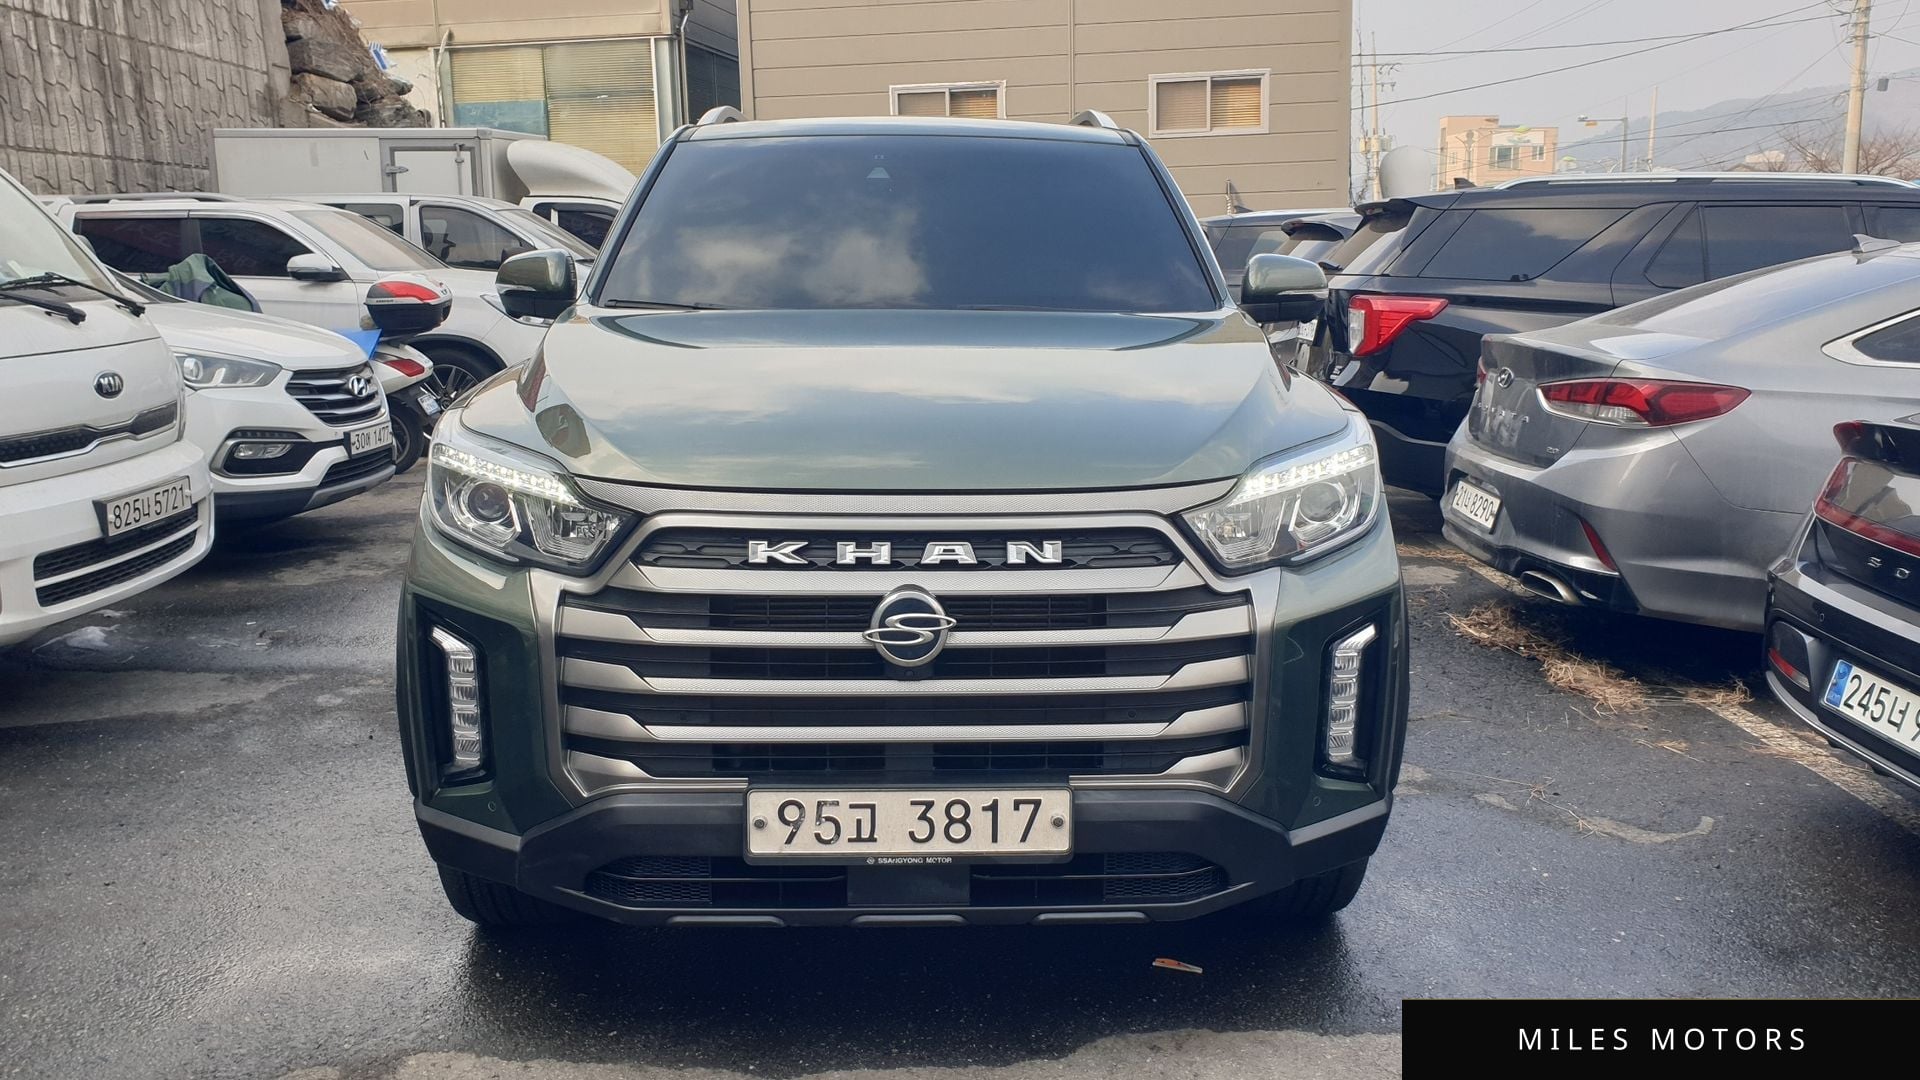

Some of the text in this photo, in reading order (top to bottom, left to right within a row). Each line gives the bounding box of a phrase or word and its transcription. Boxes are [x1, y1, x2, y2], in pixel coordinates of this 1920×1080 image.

[373, 425, 390, 445] 1477
[113, 483, 185, 530] 825나 5721
[1470, 493, 1495, 522] 8290
[747, 540, 1063, 565] KHAN
[1842, 673, 1911, 733] 245너
[776, 797, 1043, 845] 95고 3817
[877, 856, 953, 865] SSANGYONG MOTOR
